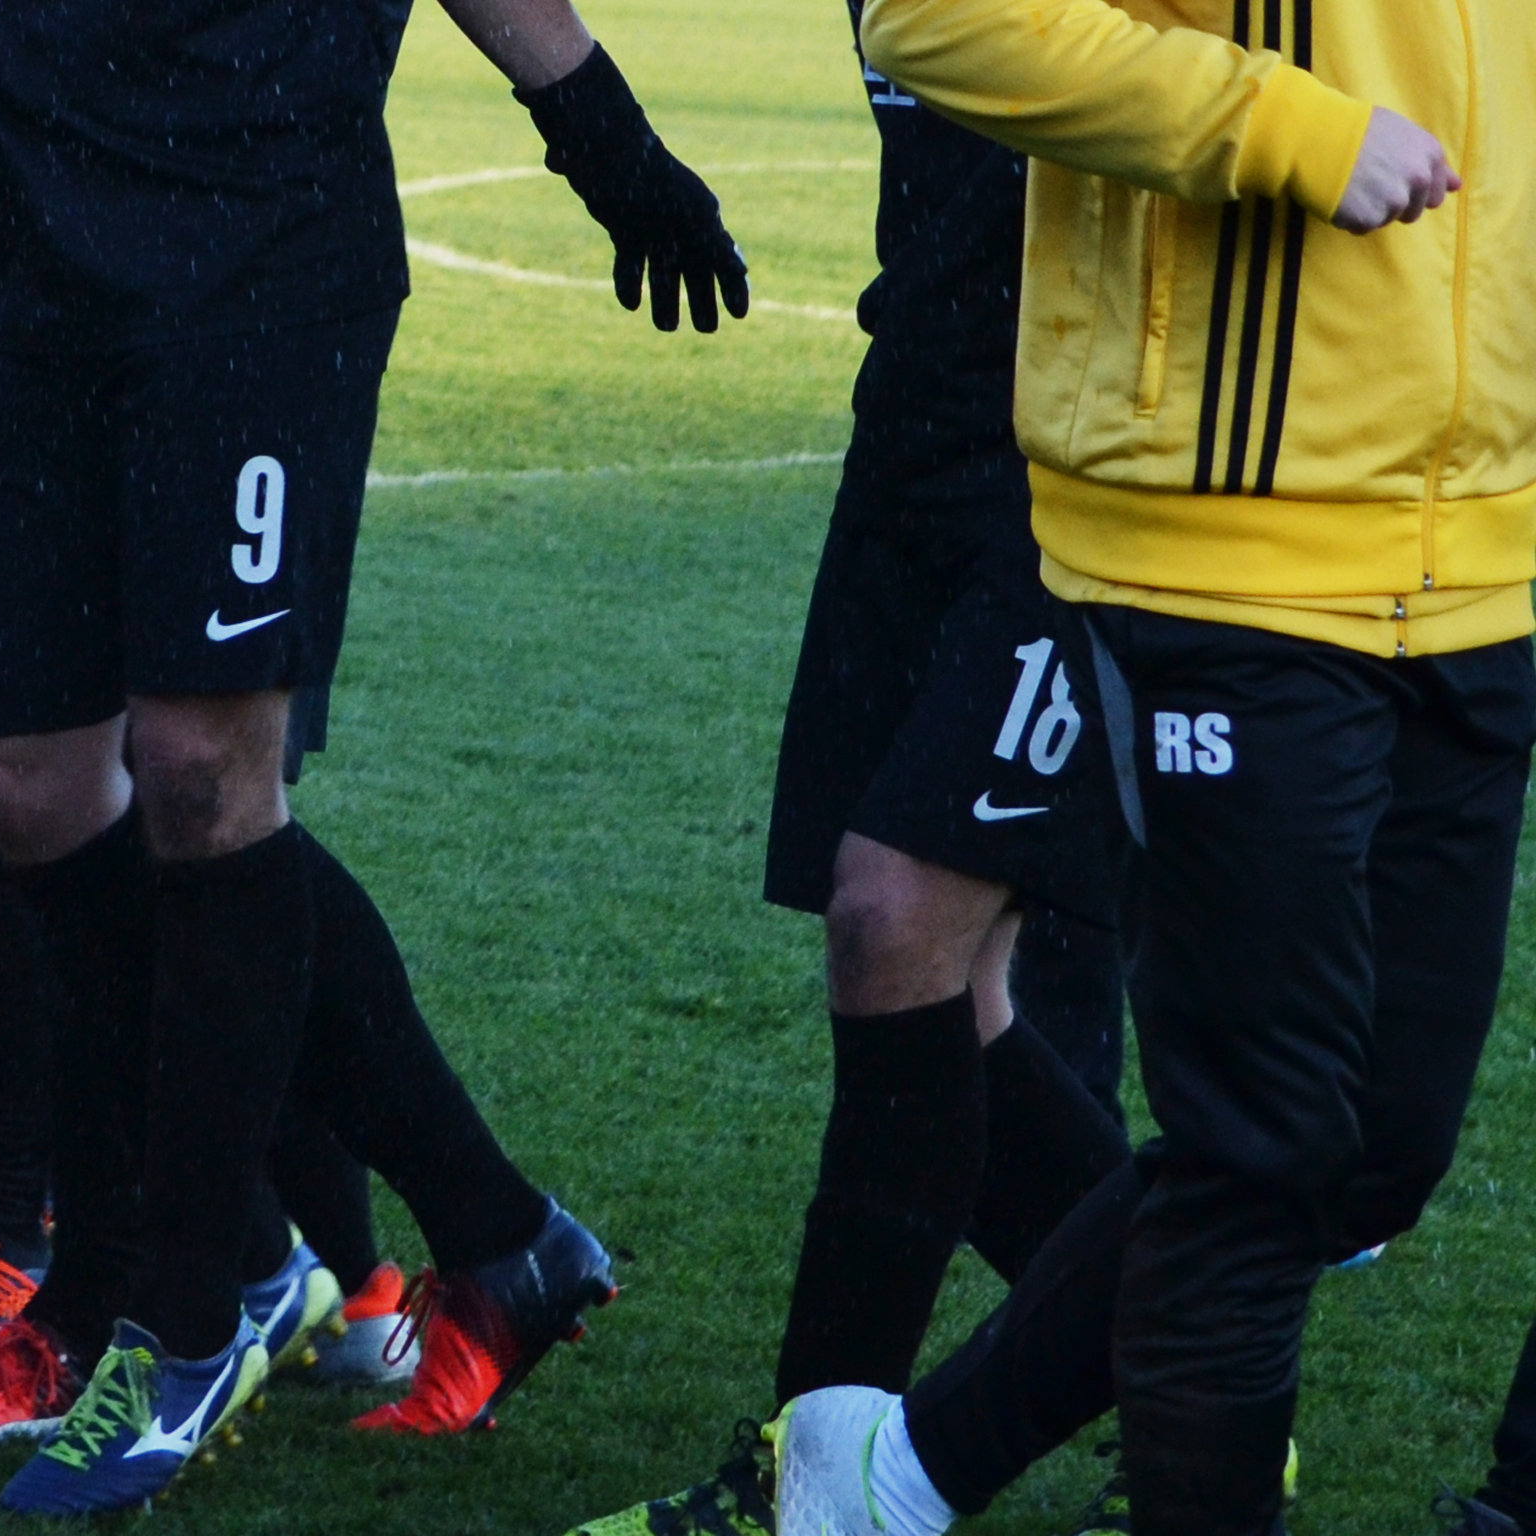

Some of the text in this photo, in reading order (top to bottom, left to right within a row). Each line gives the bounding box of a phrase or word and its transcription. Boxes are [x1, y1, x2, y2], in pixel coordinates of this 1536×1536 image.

[231, 455, 285, 584] 9
[993, 637, 1081, 775] 18
[1154, 712, 1233, 775] RS
